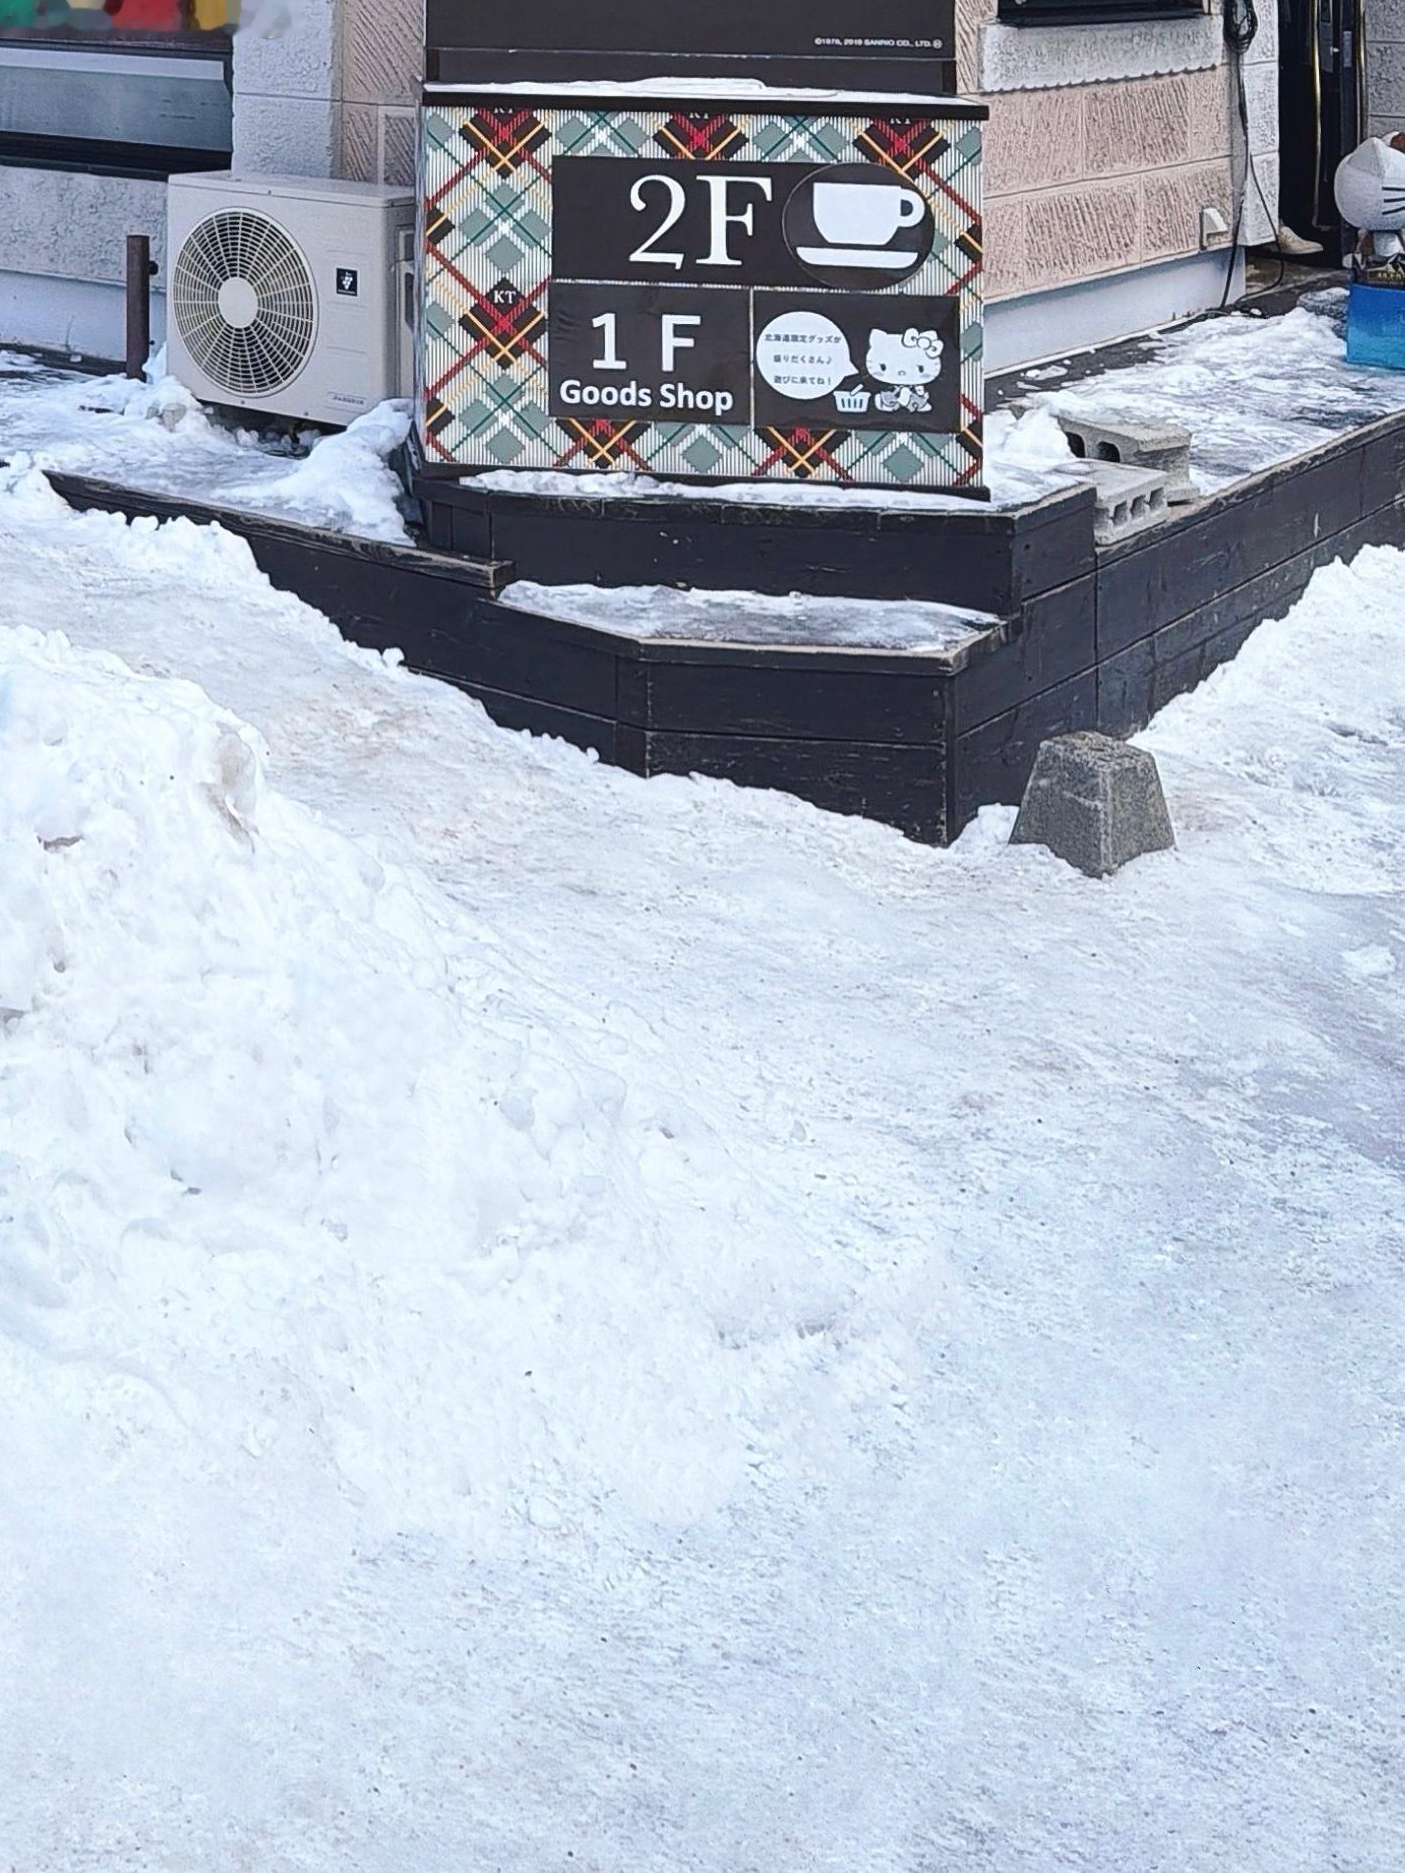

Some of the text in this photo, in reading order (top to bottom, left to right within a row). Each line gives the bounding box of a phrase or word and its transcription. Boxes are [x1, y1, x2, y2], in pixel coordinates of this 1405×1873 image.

[629, 174, 773, 270] 2F
[493, 289, 516, 304] KT
[559, 379, 733, 416] Goods Shop
